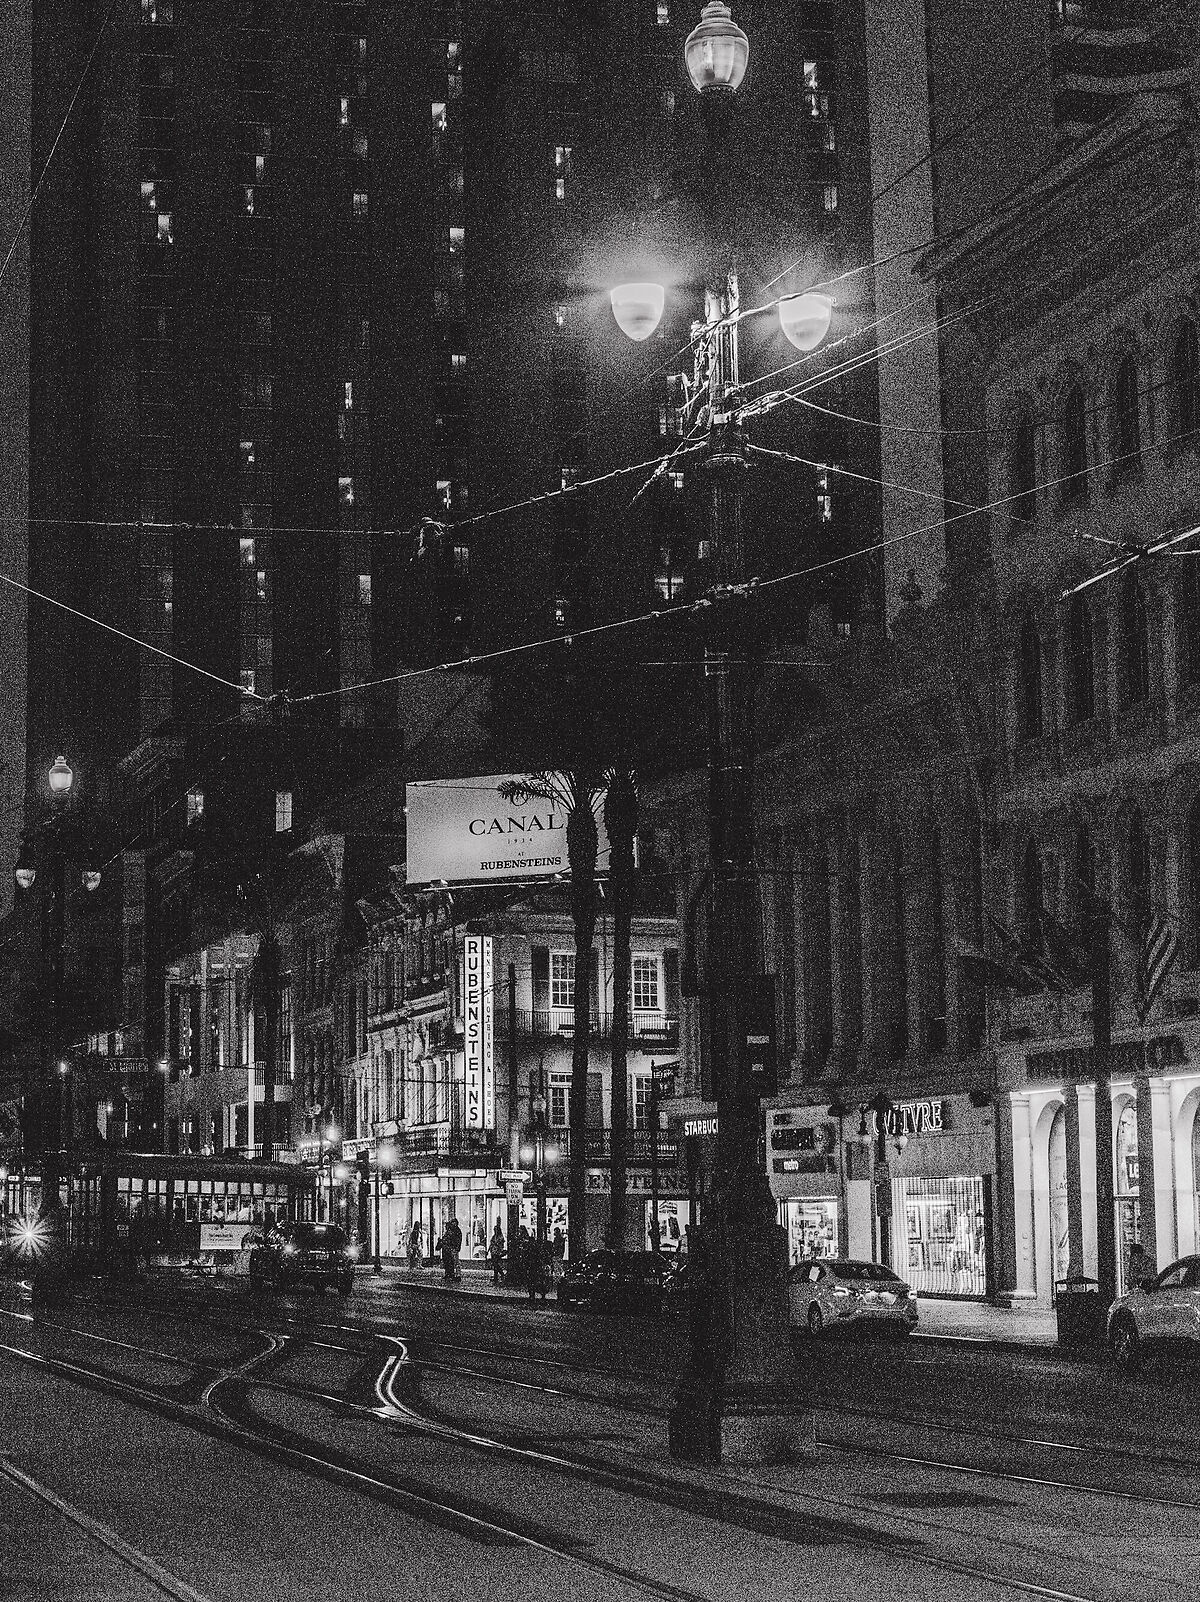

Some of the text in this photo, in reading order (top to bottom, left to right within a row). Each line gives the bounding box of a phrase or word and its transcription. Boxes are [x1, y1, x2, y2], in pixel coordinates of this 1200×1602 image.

[468, 812, 569, 836] CANAL
[480, 857, 562, 871] RUBENSTEINS
[468, 941, 479, 1121] RUBENSTEINS
